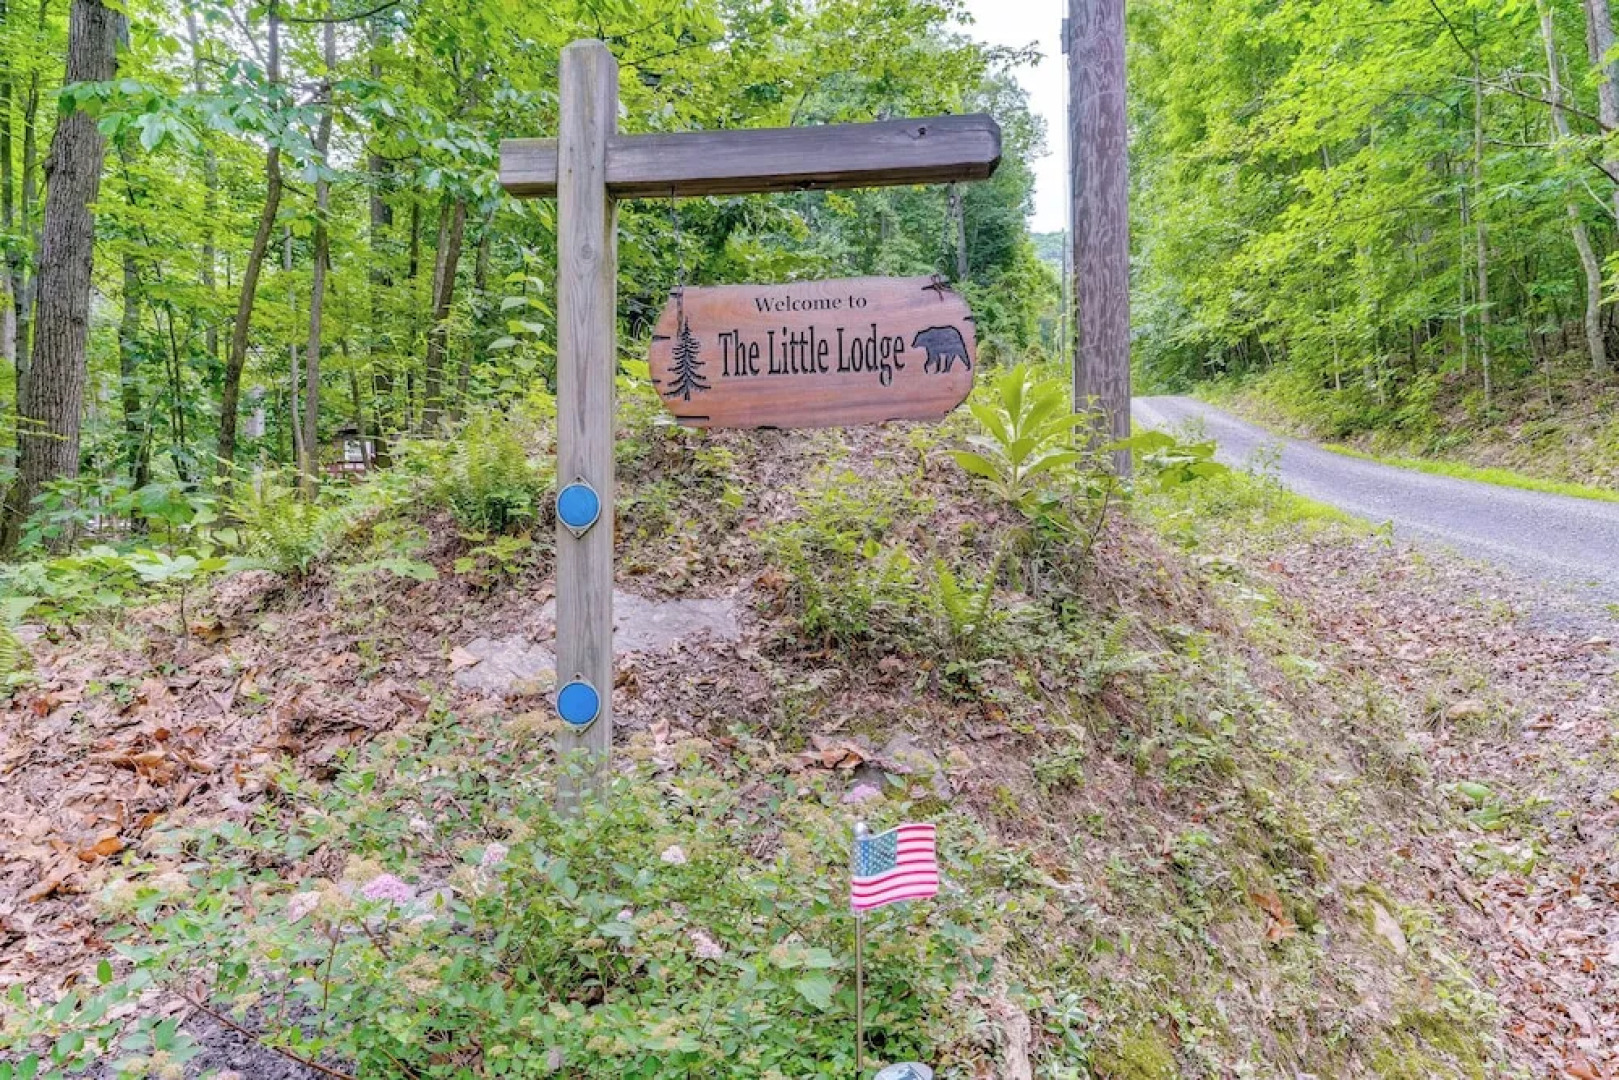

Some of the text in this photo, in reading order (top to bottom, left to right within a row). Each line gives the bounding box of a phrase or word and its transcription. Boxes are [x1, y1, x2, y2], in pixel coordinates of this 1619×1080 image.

[755, 295, 867, 312] Welcome to
[718, 323, 906, 387] The Little Lodge
